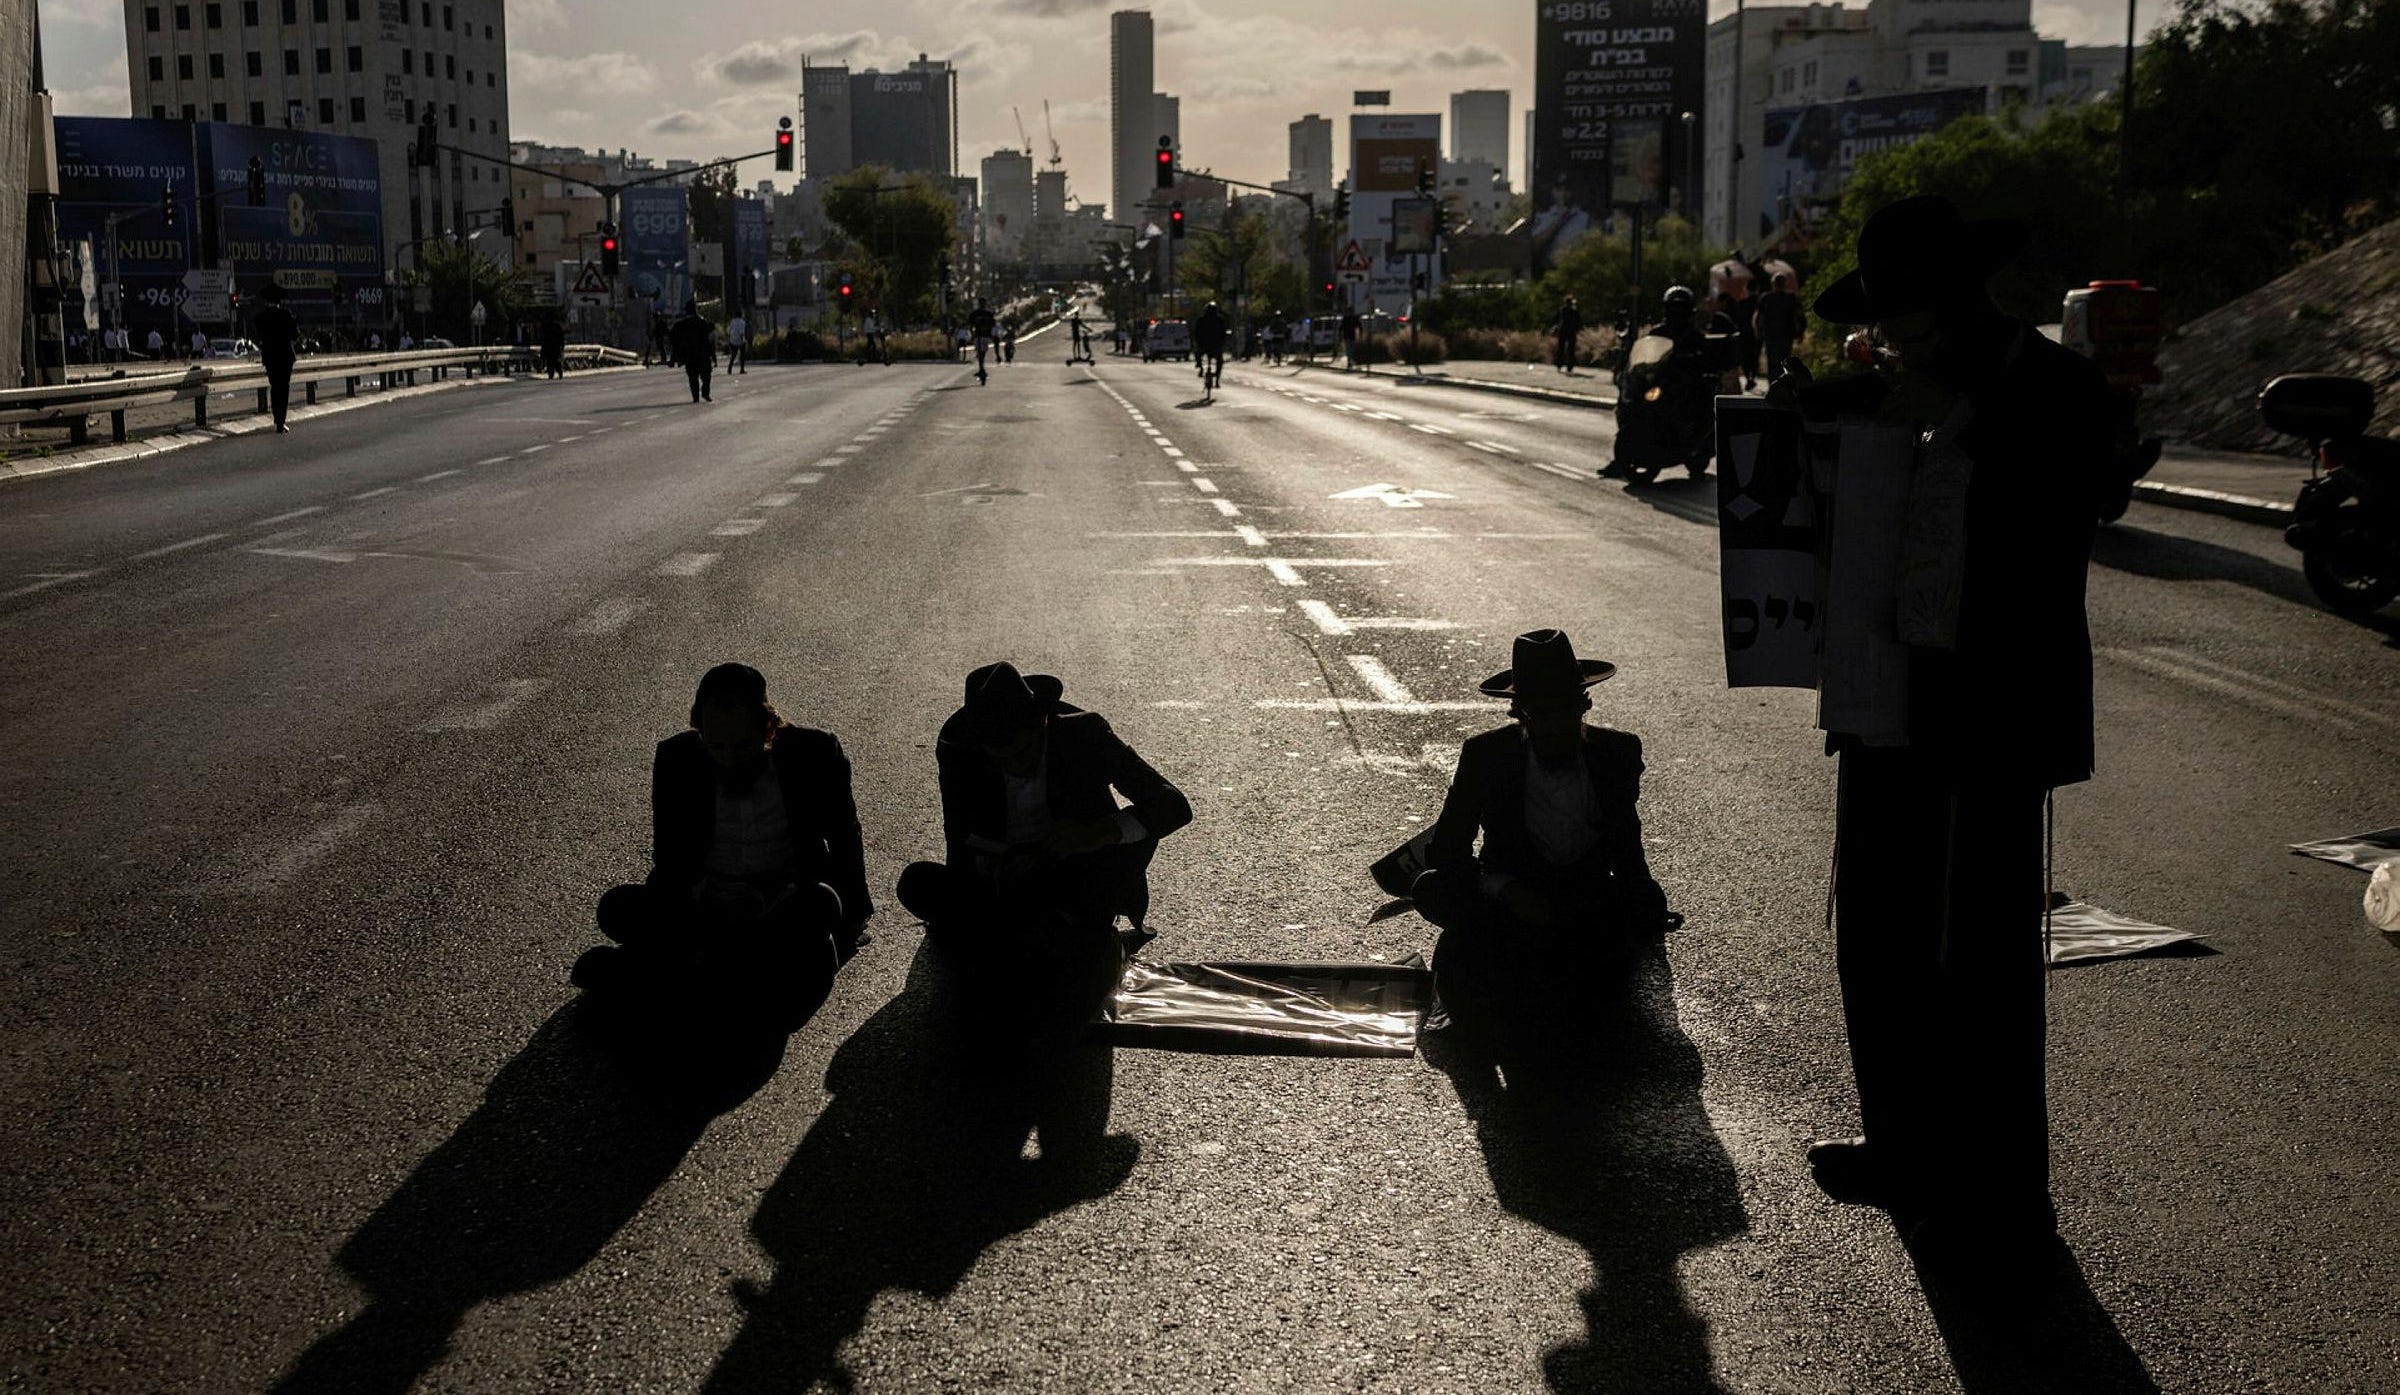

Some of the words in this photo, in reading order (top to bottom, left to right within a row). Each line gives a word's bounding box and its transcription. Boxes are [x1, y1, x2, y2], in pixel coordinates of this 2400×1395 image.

[1562, 29, 1608, 46] סודי
[1612, 26, 1675, 44] מבצע
[103, 164, 145, 178] משרד
[149, 165, 186, 180] קונים
[336, 243, 376, 263] תשואה
